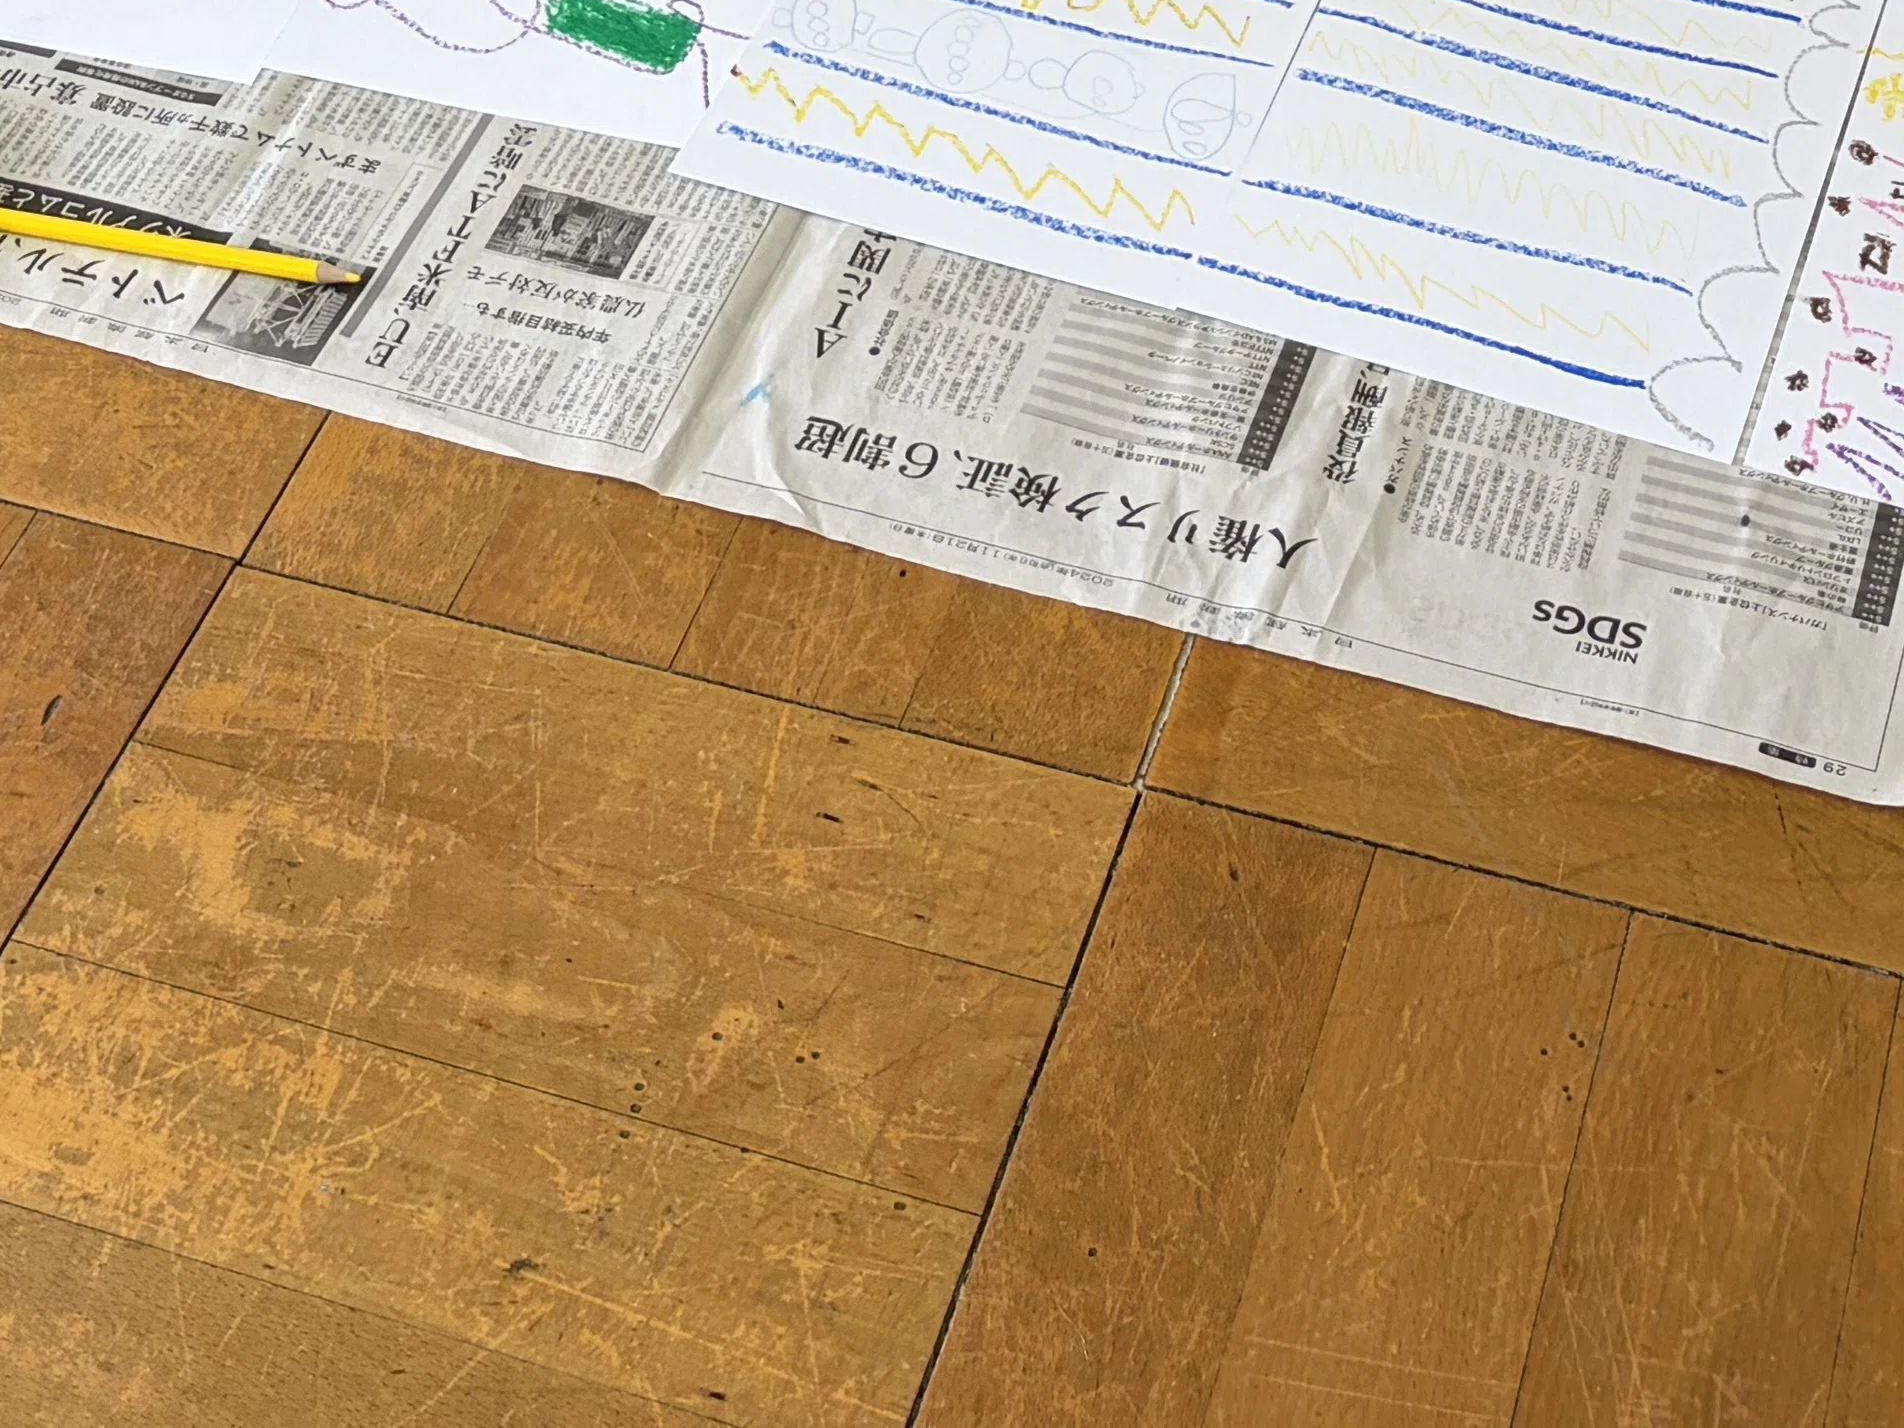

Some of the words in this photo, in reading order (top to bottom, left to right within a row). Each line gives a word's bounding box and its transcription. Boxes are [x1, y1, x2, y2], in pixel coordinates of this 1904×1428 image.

[344, 121, 540, 369] EU、南米FTAに暗雲
[458, 262, 650, 320] 仏農家が反対デモ
[790, 411, 1319, 579] 人権リスク検証、6割超
[1526, 596, 1648, 653] SDGs
[1573, 636, 1640, 666] NIKKEI
[1820, 759, 1849, 777] 29
